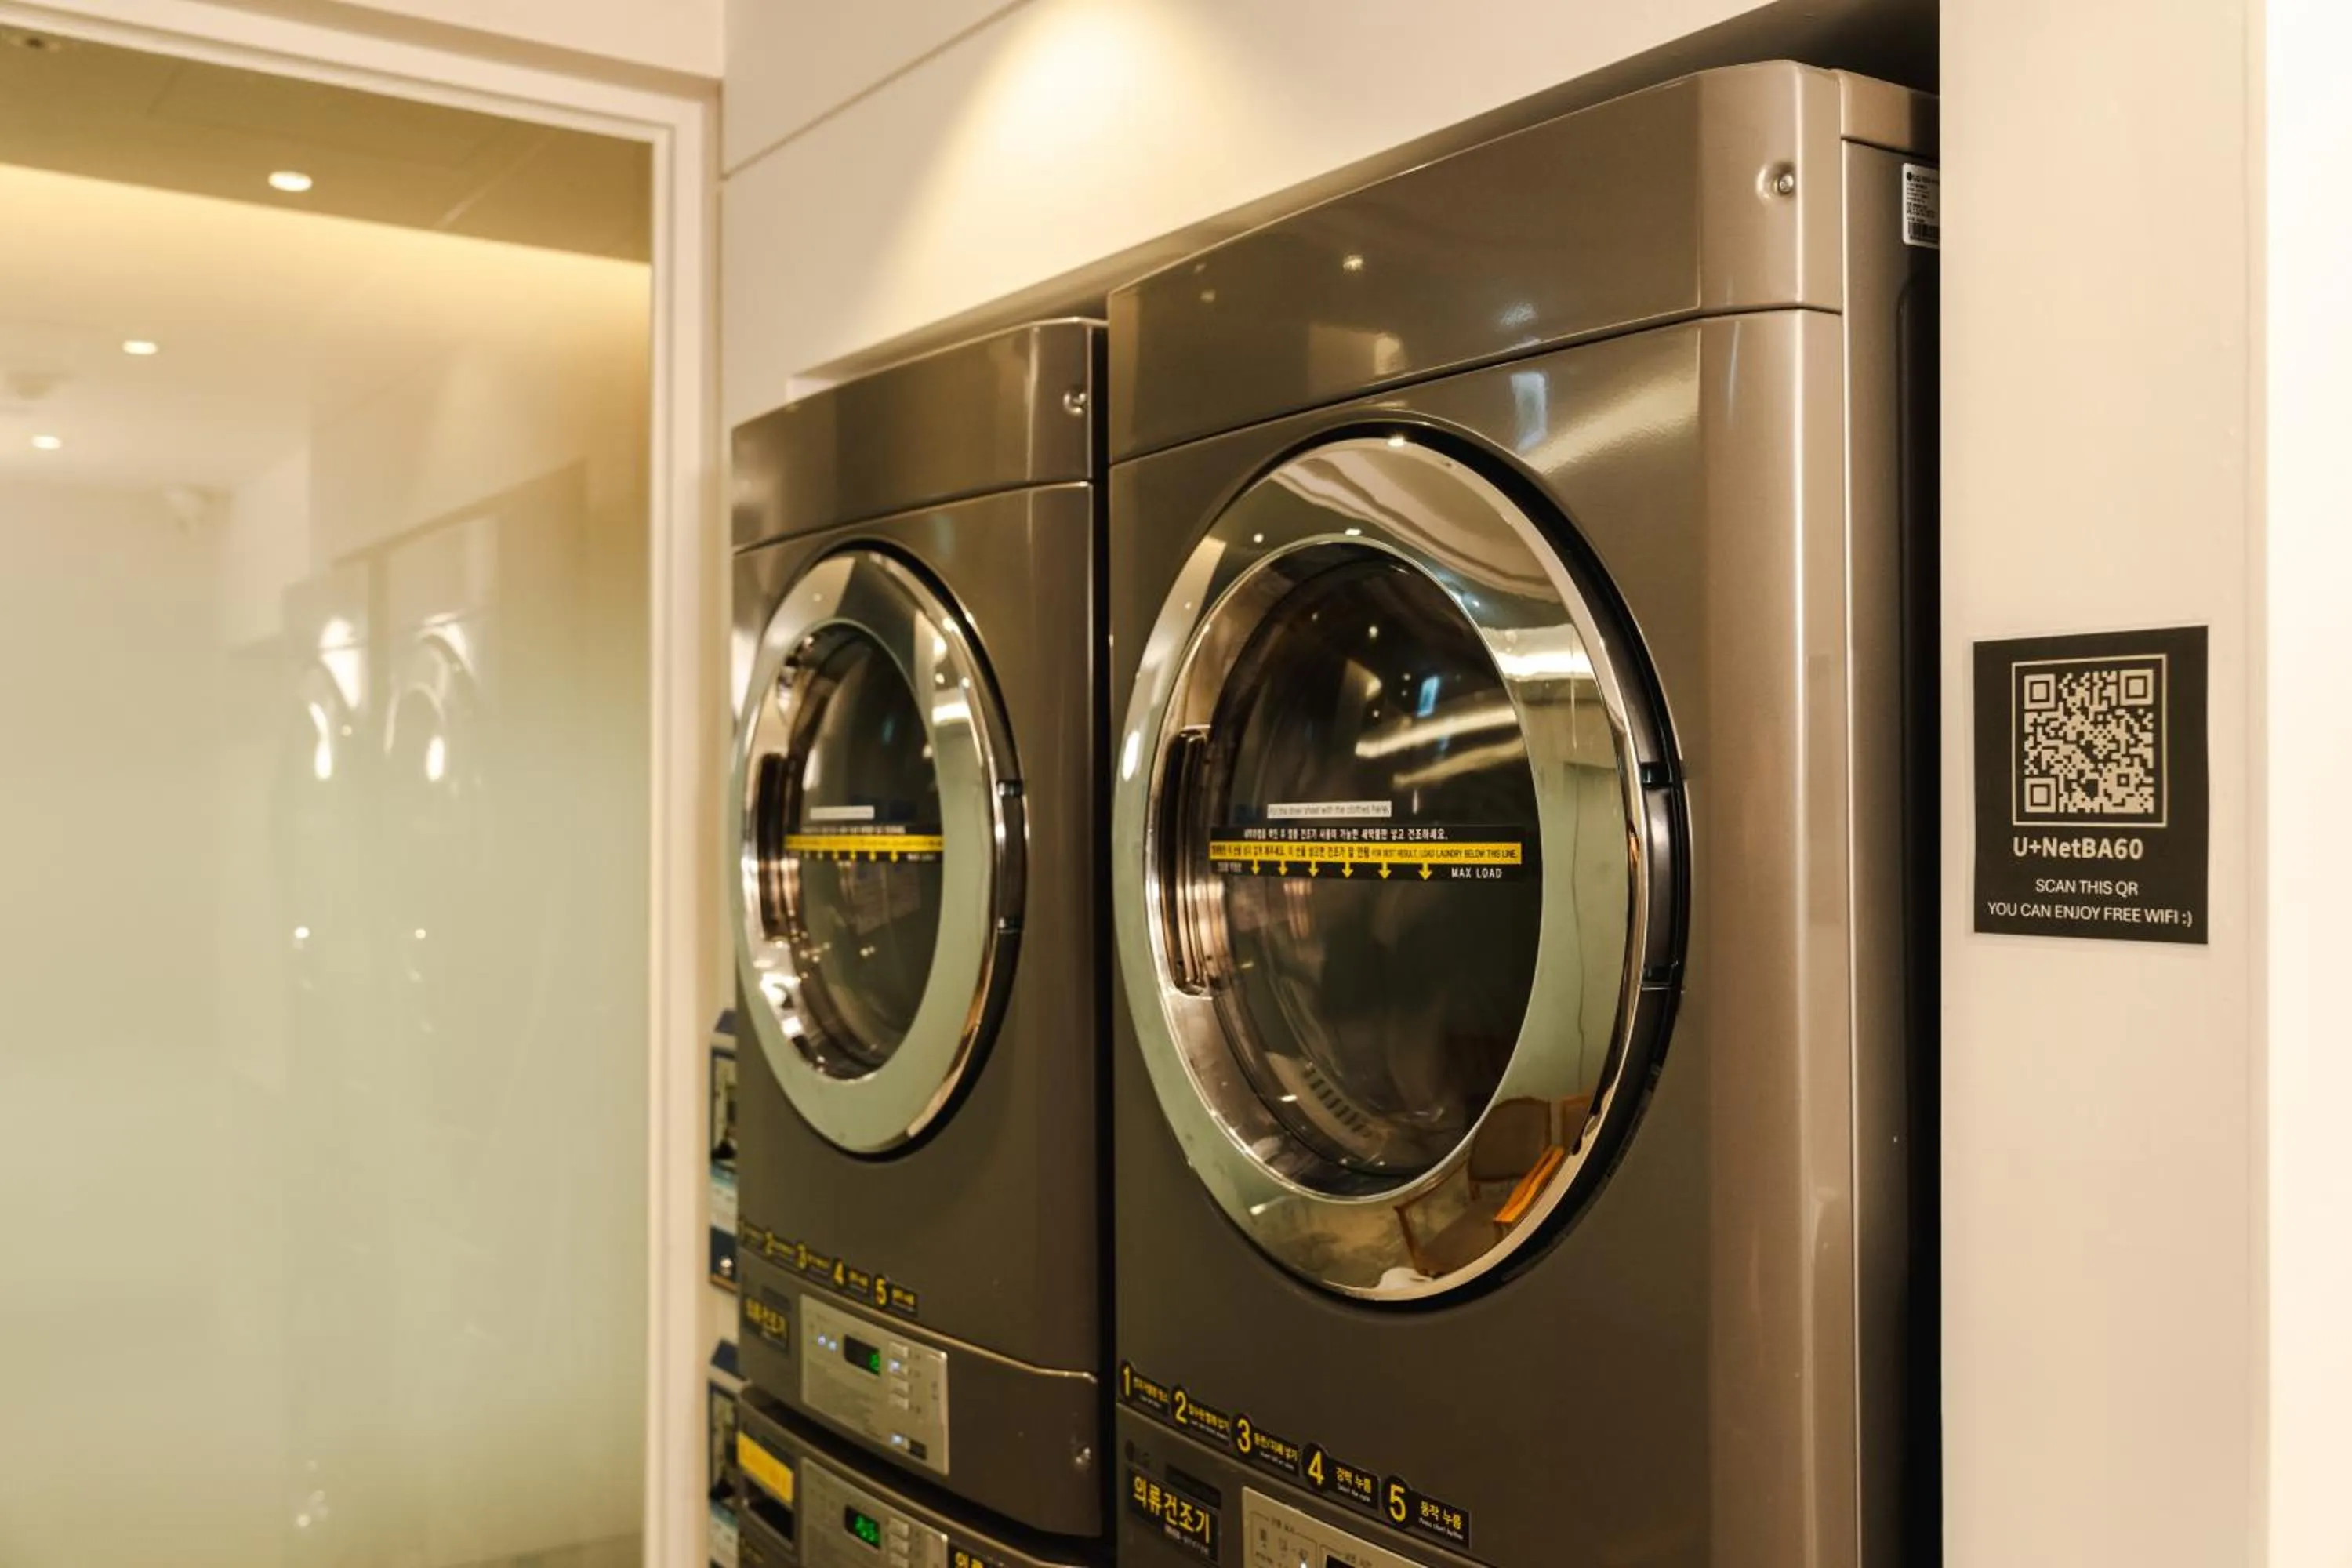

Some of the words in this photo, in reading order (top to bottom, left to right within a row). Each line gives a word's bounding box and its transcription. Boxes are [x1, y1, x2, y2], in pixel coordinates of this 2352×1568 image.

[1407, 828, 1448, 841] 건조하세요.
[1437, 849, 1463, 859] LAUNDRY
[1465, 849, 1485, 859] BELOW
[1486, 849, 1501, 859] THIS
[2013, 837, 2143, 860] U+NetBA60
[1451, 867, 1472, 878] MAX
[1476, 868, 1502, 879] LOAD
[2035, 878, 2076, 895] SCAN
[2079, 880, 2112, 895] THIS
[2115, 880, 2139, 898] QR
[1988, 902, 2017, 916] YOU
[2020, 903, 2052, 918] CAN
[2055, 904, 2100, 921] ENJOY
[2103, 906, 2141, 923] FREE
[2144, 909, 2179, 924] WIFI
[833, 1261, 844, 1286] 4
[875, 1277, 887, 1306] 5
[1123, 1366, 1131, 1396] 1
[1175, 1390, 1188, 1425] 2
[1237, 1417, 1252, 1454] 3
[1307, 1450, 1326, 1486] 4
[1134, 1475, 1210, 1544] 의류건조기
[1388, 1483, 1407, 1523] 5
[1442, 1508, 1462, 1530] 누름
